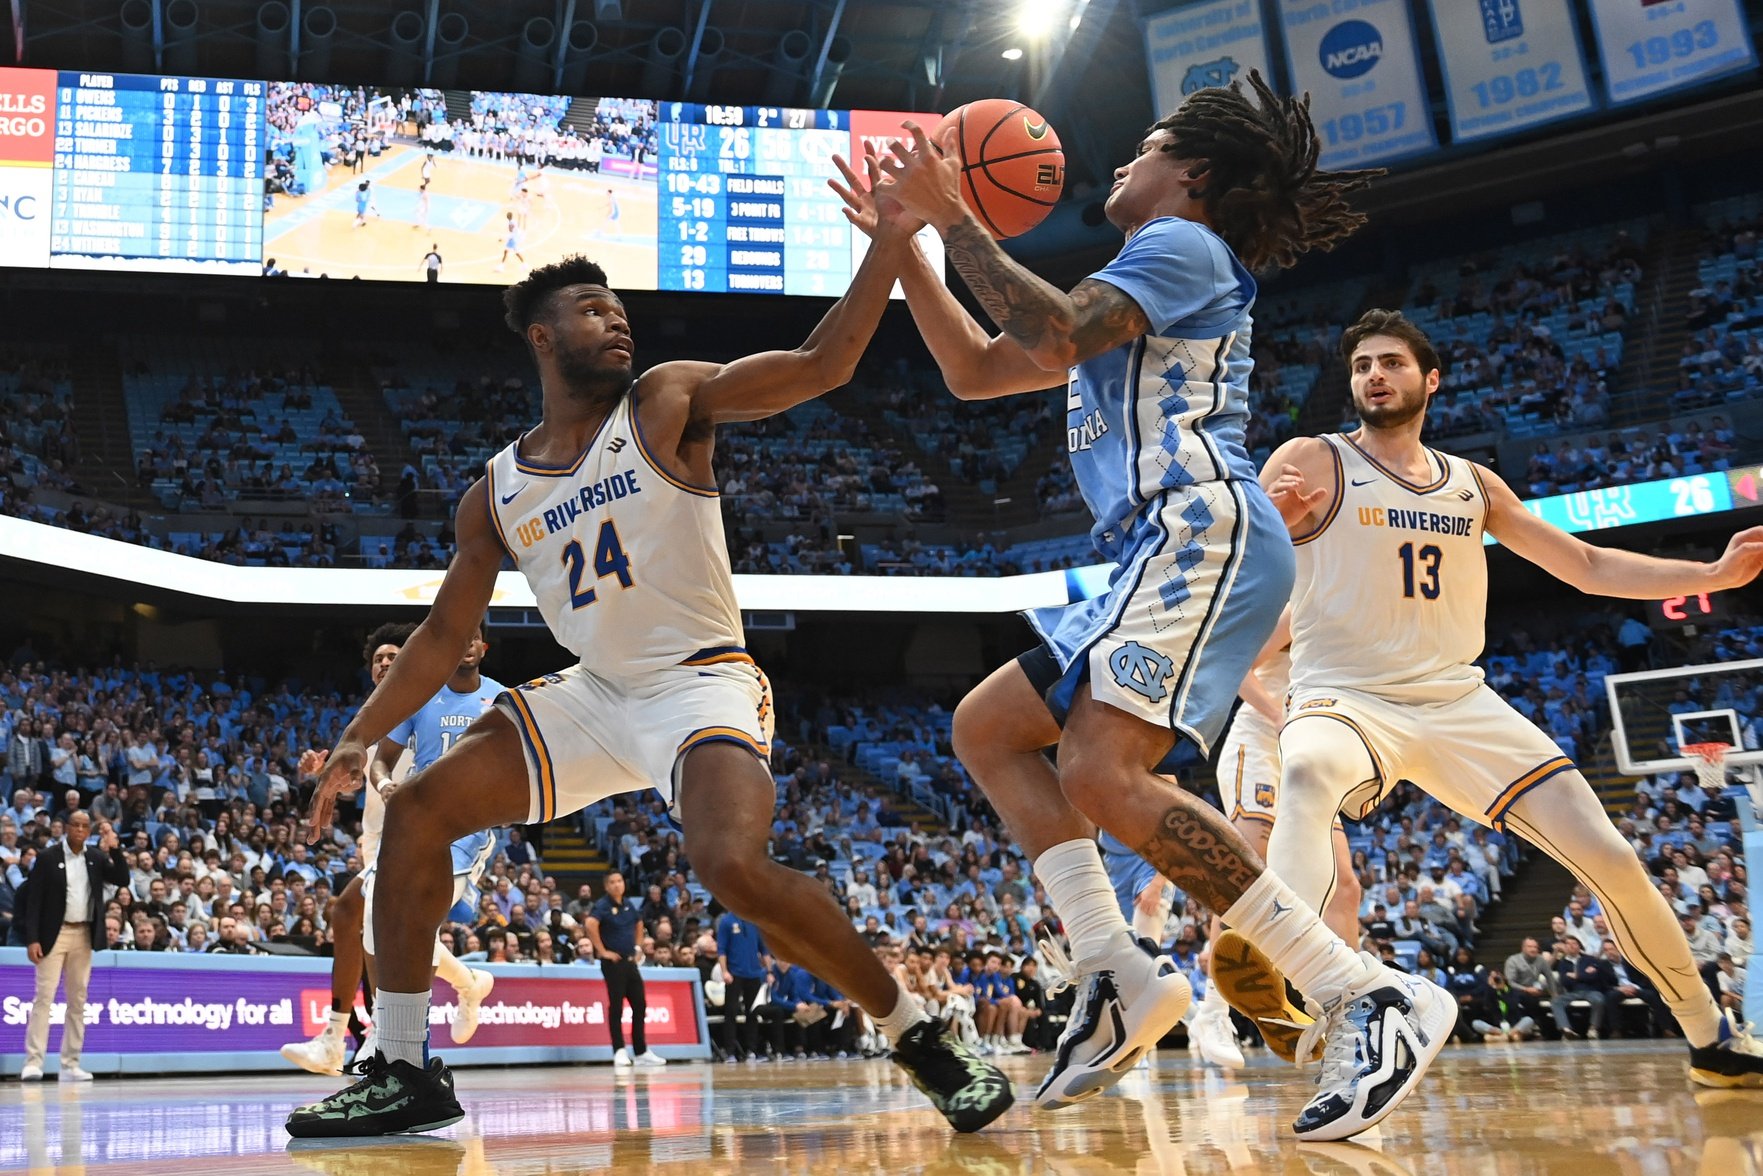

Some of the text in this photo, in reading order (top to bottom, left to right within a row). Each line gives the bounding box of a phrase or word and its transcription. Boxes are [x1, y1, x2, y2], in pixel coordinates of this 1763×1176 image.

[1327, 42, 1383, 69] NCAA
[1626, 20, 1719, 69] 1993
[1471, 61, 1567, 109] 1982
[789, 110, 806, 129] 27
[1321, 101, 1406, 146] 1957
[719, 127, 750, 159] 26
[667, 173, 721, 196] 10-43
[672, 197, 715, 218] 5-19
[731, 202, 739, 216] 3
[679, 221, 708, 242] 1-2
[681, 245, 706, 266] 29
[682, 269, 705, 289] 13
[1670, 477, 1715, 516] 26
[516, 517, 545, 548] UC
[1358, 507, 1474, 537] UC RIVERSIDE
[561, 517, 637, 611] 24
[1398, 541, 1443, 601] 13
[440, 715, 477, 728] NORT
[3, 996, 104, 1025] Sarer
[108, 996, 234, 1030] technology
[235, 997, 267, 1025] for
[269, 998, 293, 1025] all
[477, 1000, 561, 1028] technology
[562, 1001, 585, 1024] for
[586, 1002, 604, 1024] all
